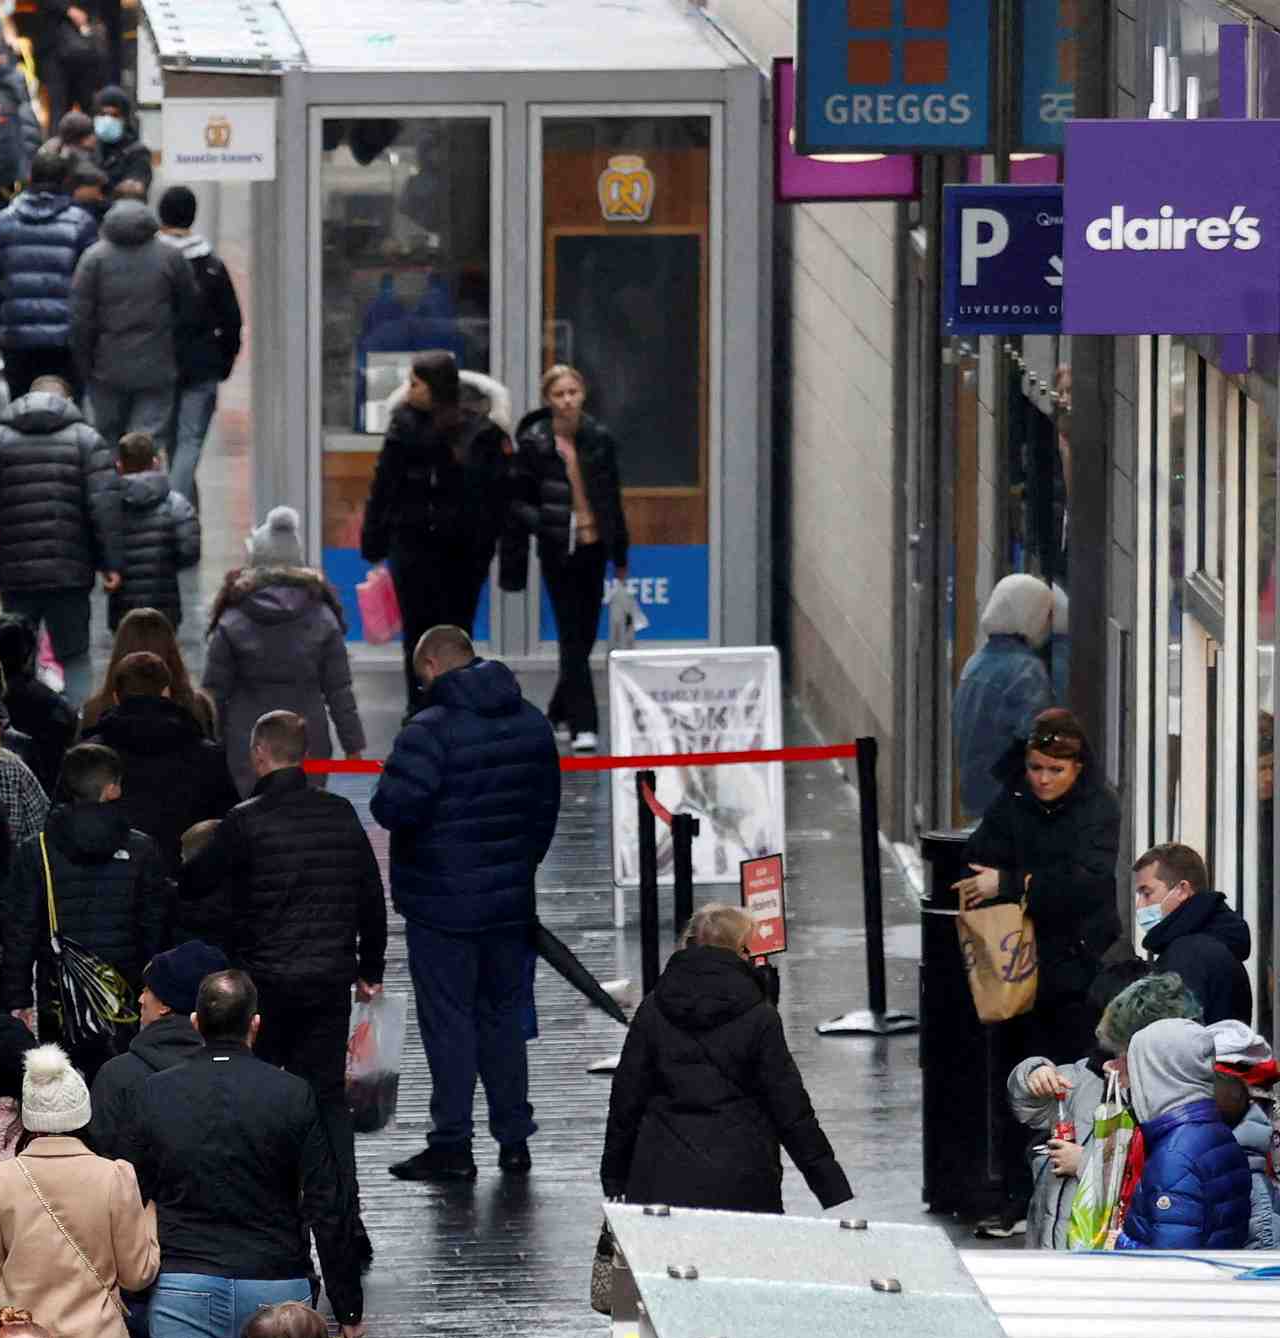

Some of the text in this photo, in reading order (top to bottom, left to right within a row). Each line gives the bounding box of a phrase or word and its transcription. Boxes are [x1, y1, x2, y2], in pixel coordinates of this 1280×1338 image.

[824, 93, 971, 125] GREGGS
[960, 207, 1010, 287] P
[1086, 205, 1262, 251] claire's
[959, 303, 1064, 316] LIVERPOOL O
